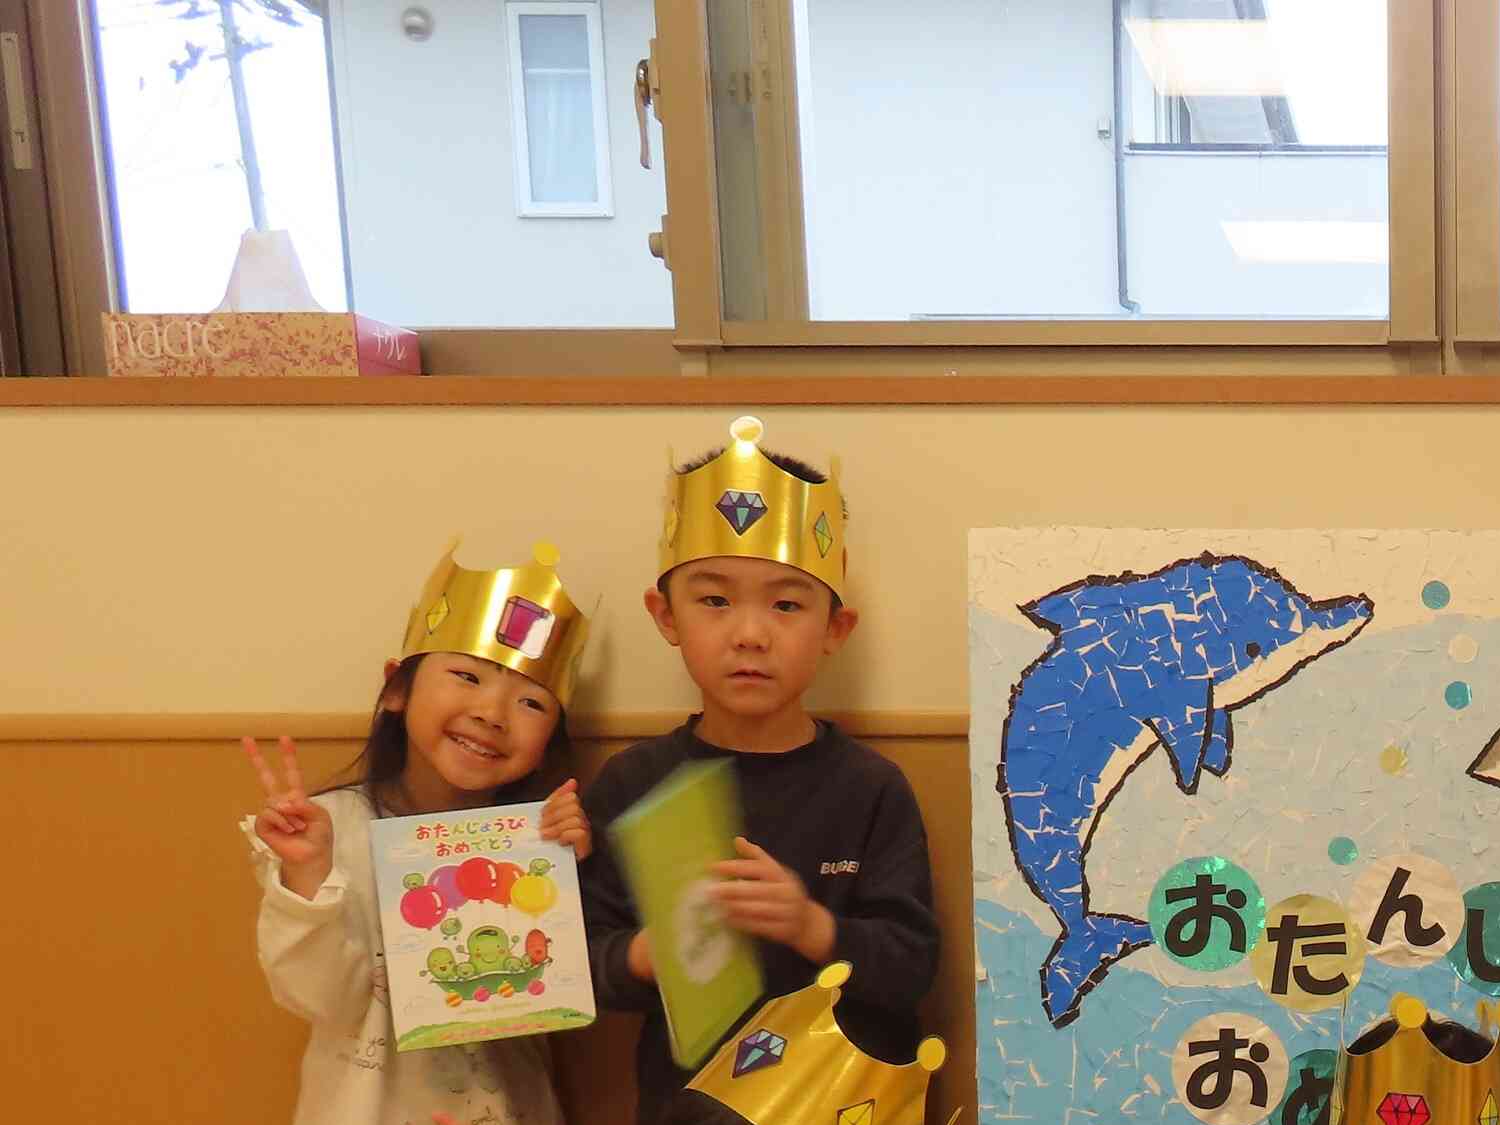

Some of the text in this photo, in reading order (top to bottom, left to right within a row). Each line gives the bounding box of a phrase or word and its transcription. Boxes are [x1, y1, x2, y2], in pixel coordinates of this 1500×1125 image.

[110, 318, 226, 360] nacre
[415, 815, 528, 841] おたんじょうび
[435, 835, 513, 857] おめでとう
